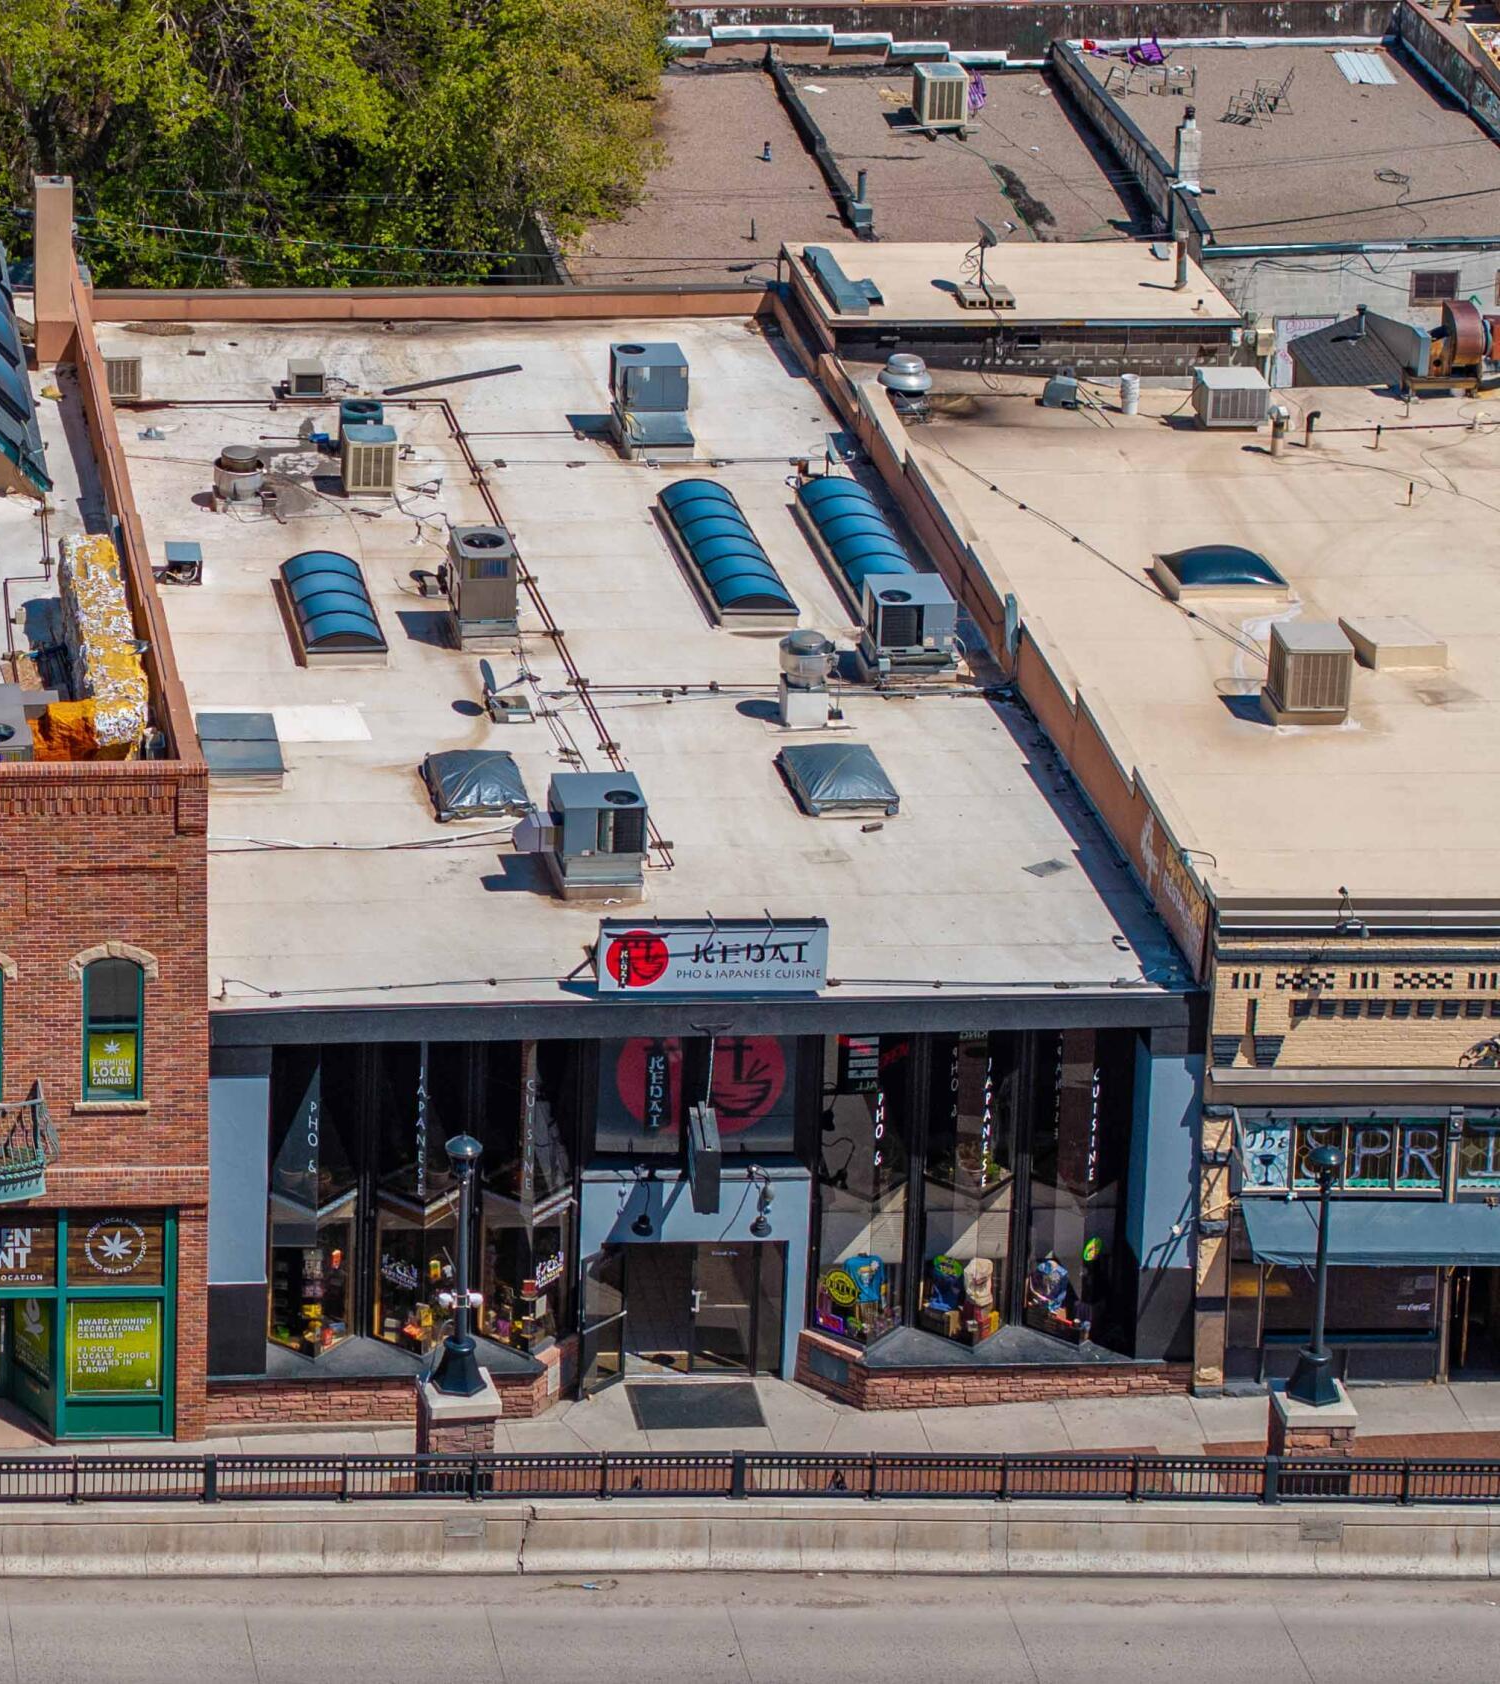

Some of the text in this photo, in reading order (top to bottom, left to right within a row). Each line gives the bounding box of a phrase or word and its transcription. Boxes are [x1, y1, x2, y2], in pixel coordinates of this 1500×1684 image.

[676, 968, 821, 979] PHO & JAPANESE CUISINE
[691, 941, 809, 964] KEDAI
[92, 1067, 132, 1077] LOCAL
[92, 1077, 132, 1085] CANNABIS
[649, 1056, 665, 1127] KEDAI
[307, 1101, 318, 1174] PHO &
[416, 1066, 426, 1196] JAPANESE
[524, 1079, 535, 1190] CUISINE
[875, 1092, 884, 1139] PHO
[981, 1057, 993, 1187] JAPANESE
[1087, 1068, 1100, 1181] CUISINE
[1246, 1129, 1289, 1150] The
[77, 1318, 152, 1326] AWARD-WINNING
